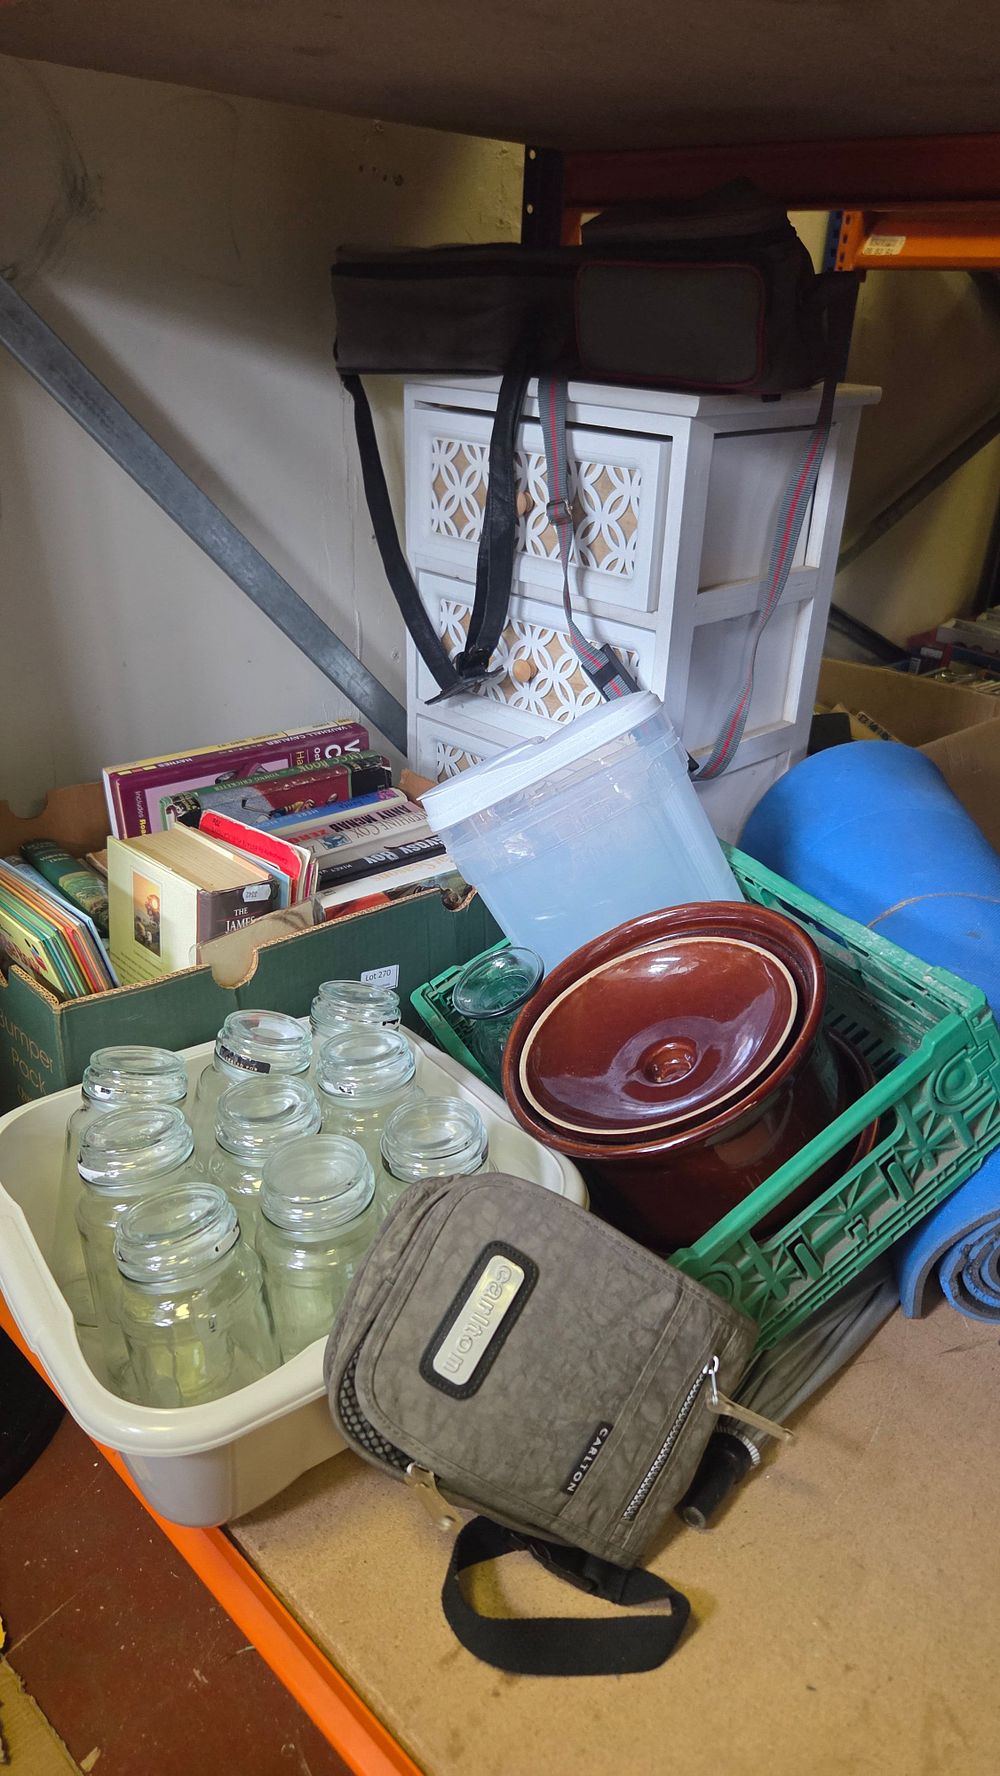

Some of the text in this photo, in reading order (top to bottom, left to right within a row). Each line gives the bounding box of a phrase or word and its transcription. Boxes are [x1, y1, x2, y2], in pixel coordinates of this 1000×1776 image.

[295, 750, 305, 766] Ha
[377, 803, 412, 820] ANDY
[233, 906, 249, 917] THE
[365, 968, 392, 983] Lot 270
[566, 1426, 609, 1493] CARLTON
